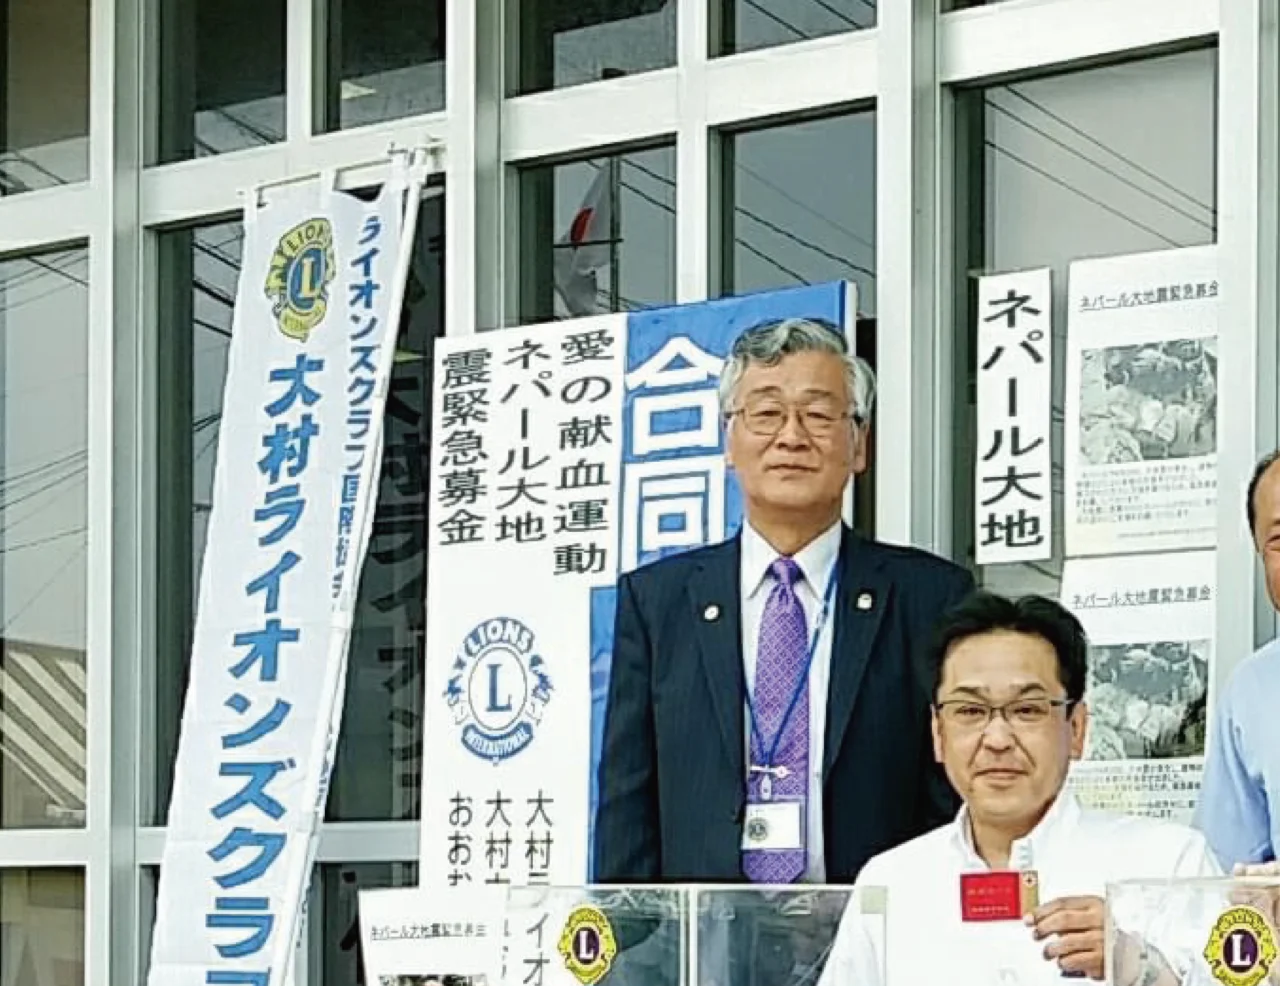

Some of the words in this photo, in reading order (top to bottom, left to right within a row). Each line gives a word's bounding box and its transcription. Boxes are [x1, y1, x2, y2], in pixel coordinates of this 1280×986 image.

[437, 347, 493, 546] 震緊急募金
[494, 338, 553, 544] ネパール大地
[552, 328, 615, 577] 愛の献血運動
[980, 289, 1044, 549] ネパール大地
[464, 618, 534, 656] LIONS
[485, 663, 513, 712] L
[1230, 933, 1252, 967] L
